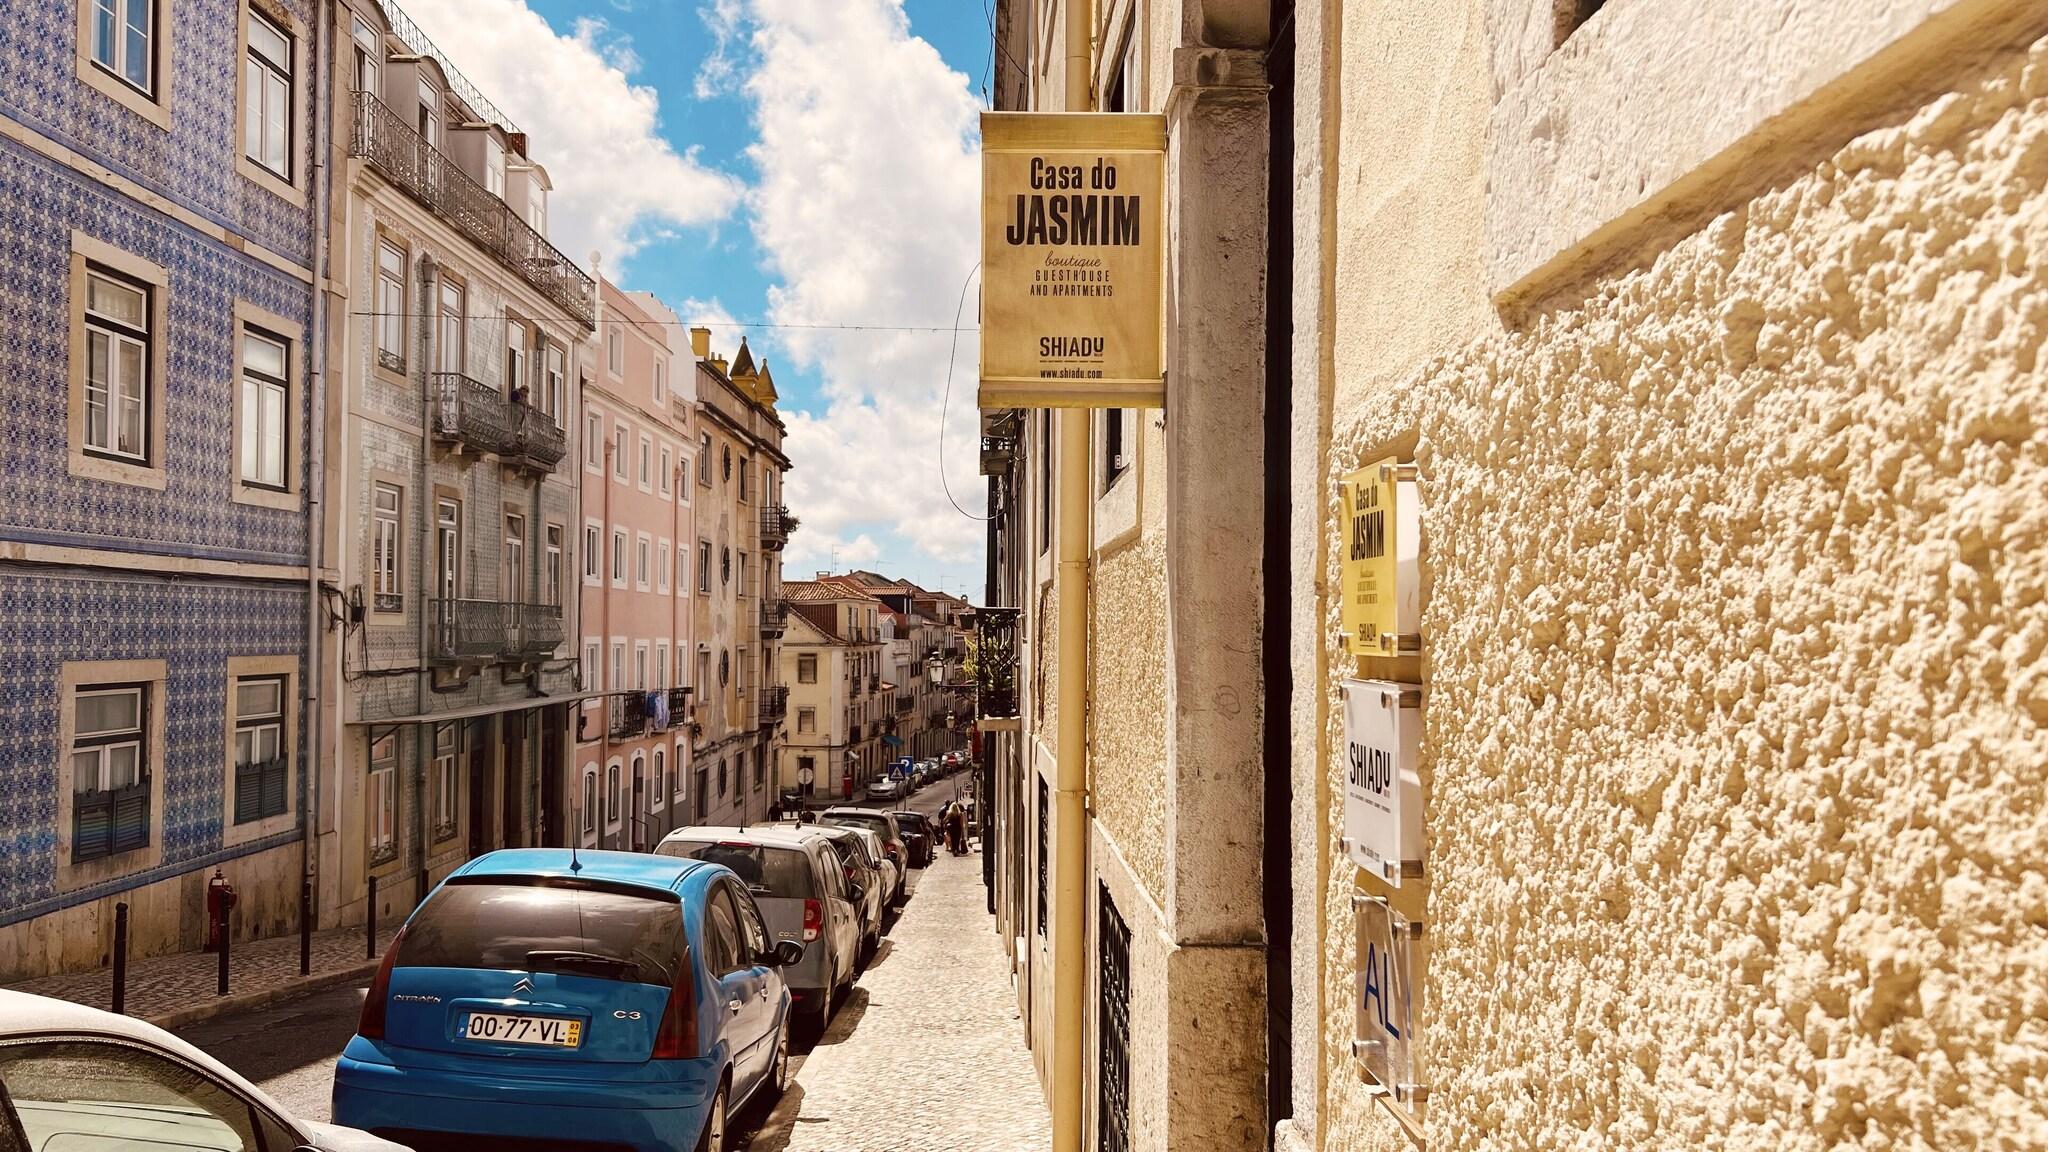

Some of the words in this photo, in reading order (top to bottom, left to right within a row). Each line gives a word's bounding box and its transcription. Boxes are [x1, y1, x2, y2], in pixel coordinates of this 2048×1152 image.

[1030, 157, 1083, 190] Casa
[1091, 157, 1116, 190] do
[1006, 194, 1140, 246] JASMIM
[1035, 269, 1110, 282] GUESTHOUSE
[1045, 250, 1102, 275] boutique
[1030, 284, 1048, 296] AND
[1052, 284, 1113, 297] APARTMENTS
[1039, 336, 1104, 357] SHIADU
[1040, 367, 1103, 379] www.shiadu.com
[1355, 482, 1369, 511] Casa
[1371, 477, 1378, 507] do
[1350, 510, 1384, 561] JASMIM
[1349, 741, 1391, 794] SHIADU
[1363, 941, 1400, 1041] AL
